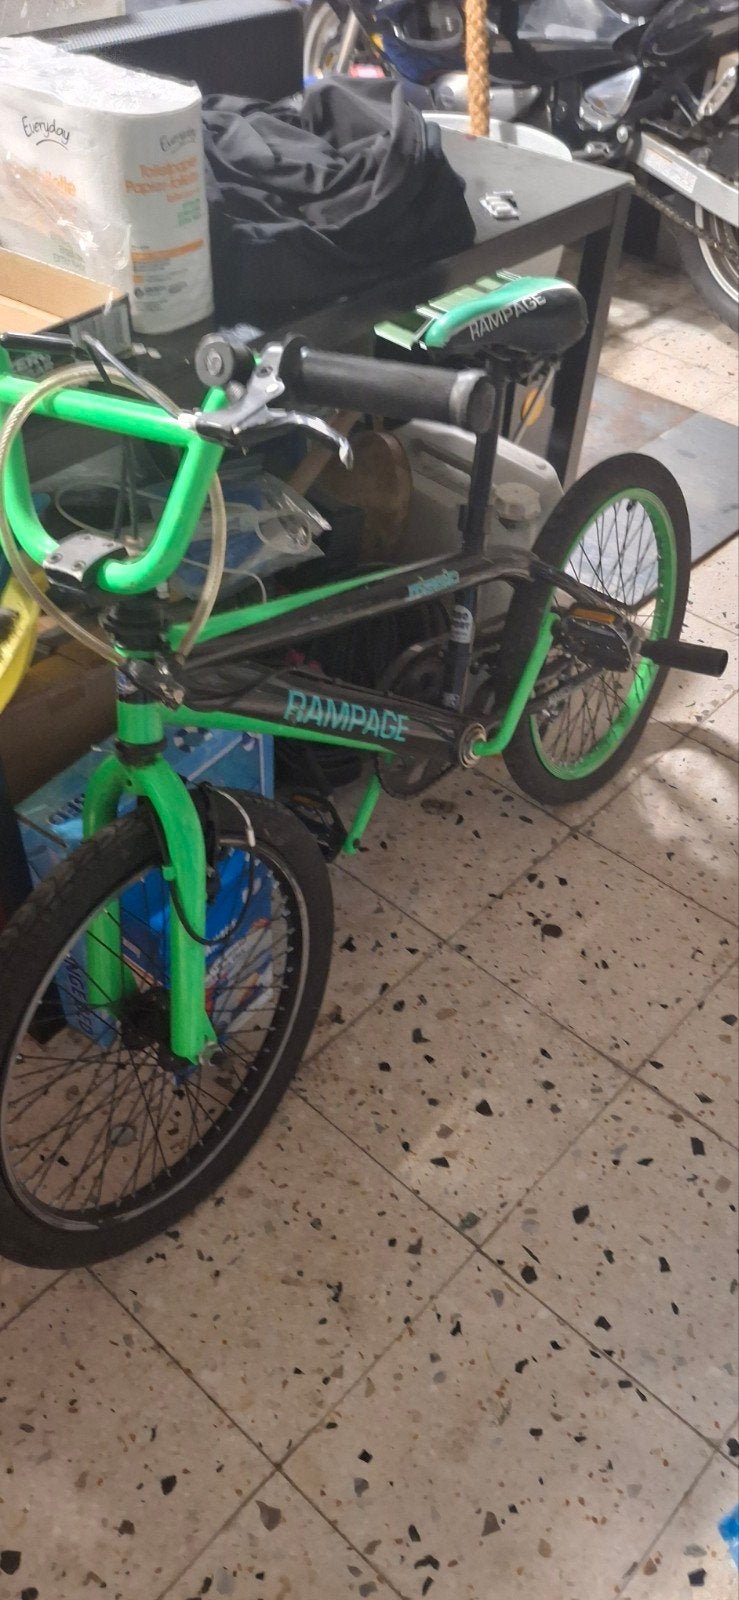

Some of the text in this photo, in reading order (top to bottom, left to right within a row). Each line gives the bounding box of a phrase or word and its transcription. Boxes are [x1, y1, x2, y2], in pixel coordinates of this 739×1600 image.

[22, 115, 71, 144] Everyday
[469, 296, 547, 341] RAMPAGE
[283, 690, 410, 742] RAMPAGE
